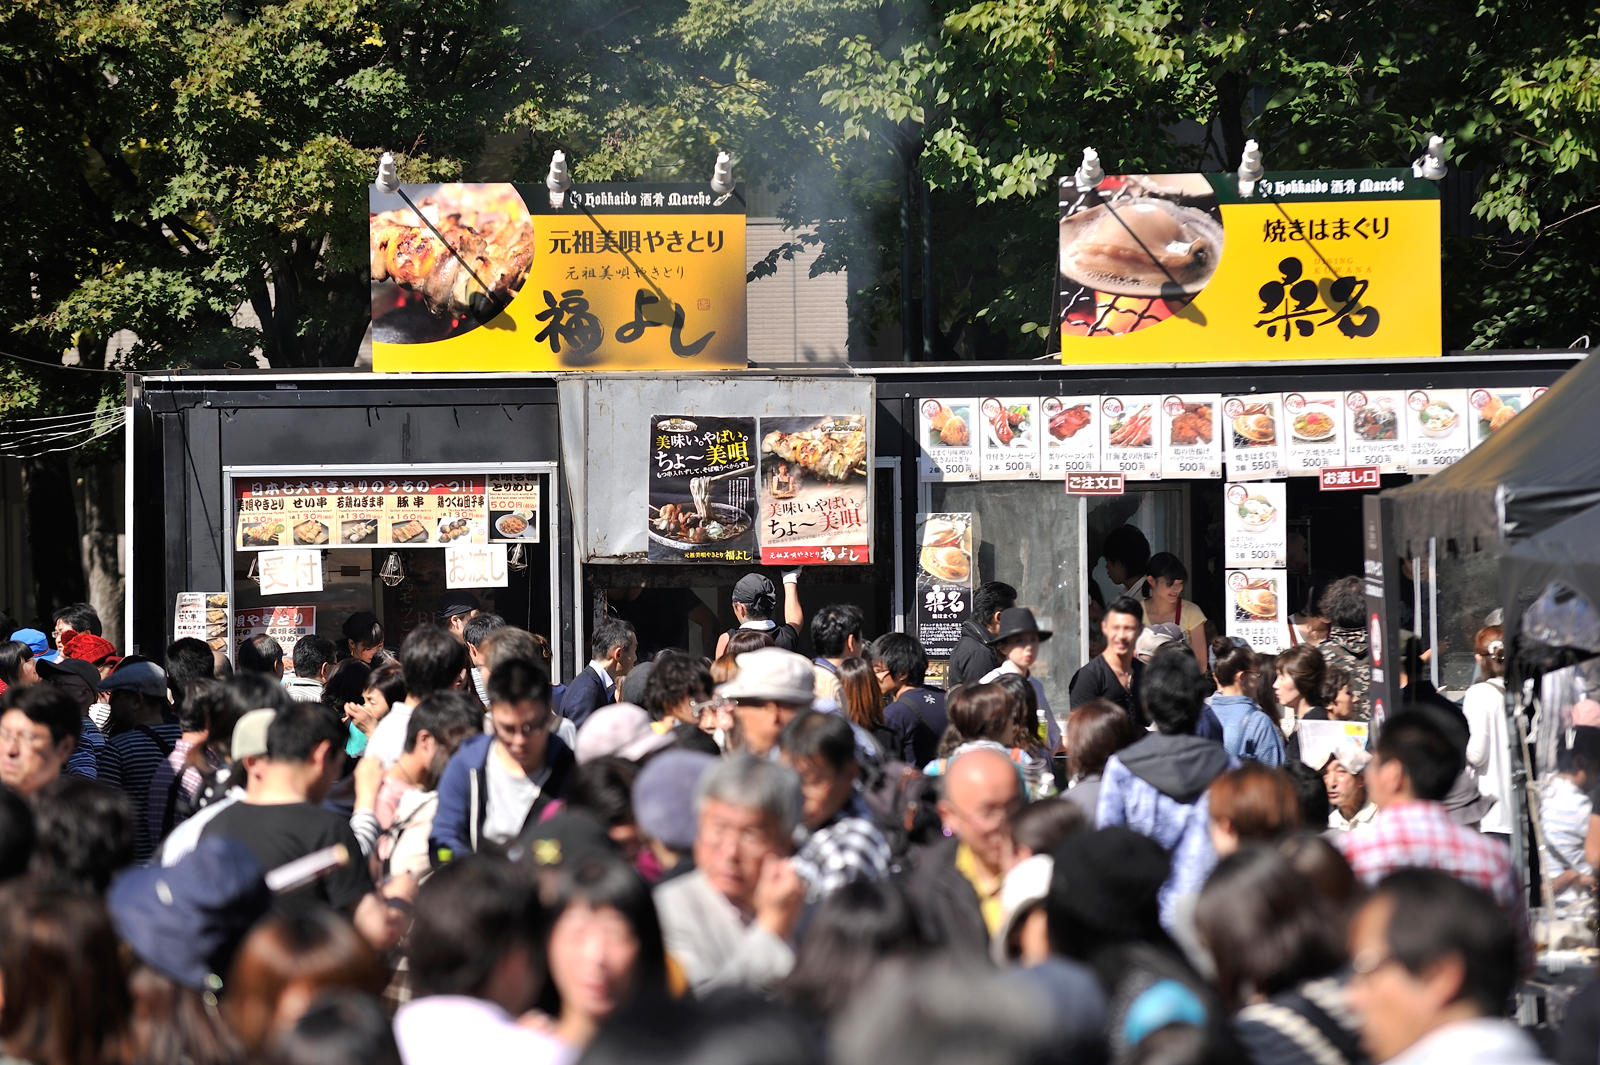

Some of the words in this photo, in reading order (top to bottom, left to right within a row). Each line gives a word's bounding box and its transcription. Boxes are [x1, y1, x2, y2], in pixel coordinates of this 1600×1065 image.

[1274, 179, 1329, 197] Hokkaido
[1359, 177, 1404, 193] Marche
[585, 190, 637, 208] Hokkaido
[640, 192, 665, 207] 酒肴
[668, 191, 711, 207] Marche
[1263, 216, 1389, 243] 焼きはまぐり
[548, 229, 724, 255] 元祖美唄やきとり
[565, 265, 685, 281] 元祖美唄やきとり
[534, 288, 716, 358] 福よし
[1068, 476, 1122, 490] ご注文口
[1323, 470, 1377, 485] お渡し口
[492, 482, 534, 492] とりめし
[292, 497, 328, 509] せい串
[336, 496, 384, 509] 若鶏ねぎま串
[437, 495, 485, 509] 鶏つくね団子串
[725, 549, 752, 561] 福よし
[820, 546, 860, 562] 福よし
[262, 553, 318, 589] 受付
[449, 550, 505, 584] お渡し
[269, 627, 306, 635] 美唄名物
